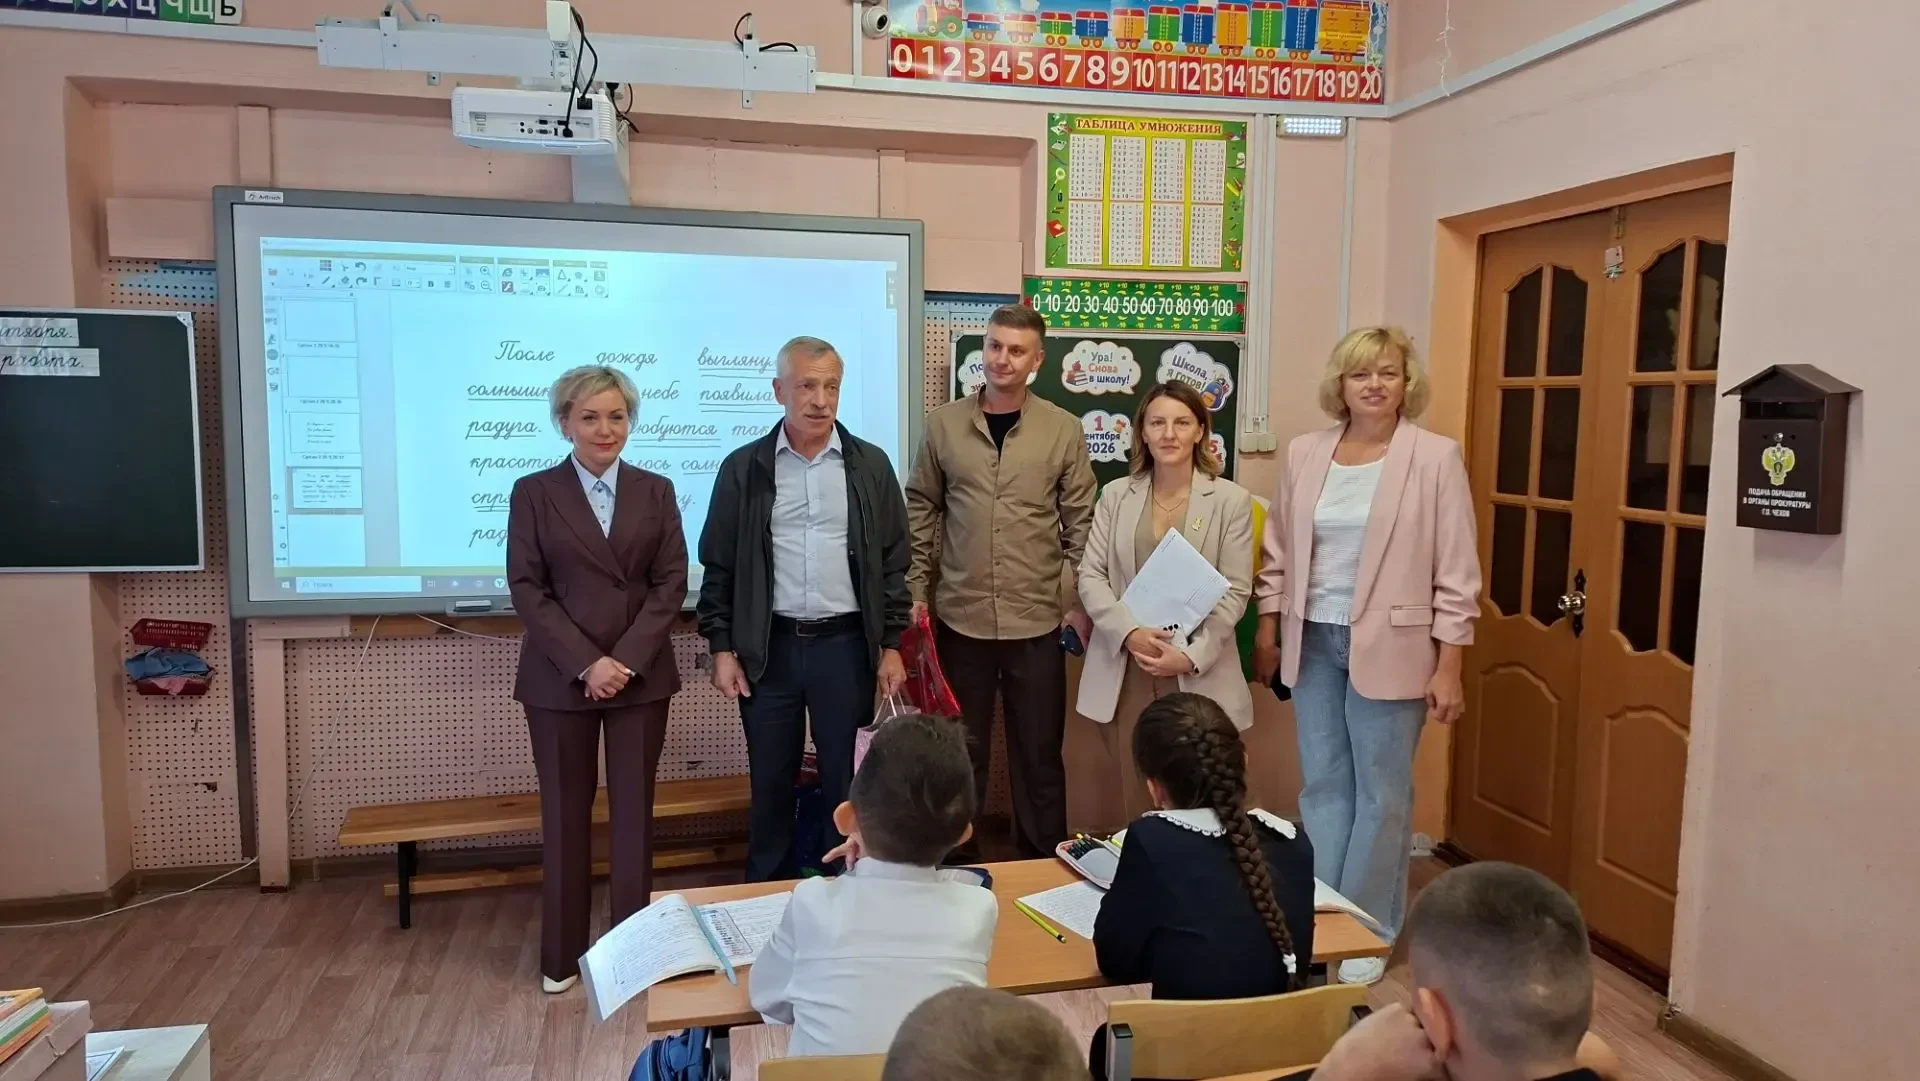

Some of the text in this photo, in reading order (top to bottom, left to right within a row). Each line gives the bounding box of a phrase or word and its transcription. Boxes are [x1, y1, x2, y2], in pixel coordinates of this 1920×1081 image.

[893, 44, 1382, 100] 0 1 2 3 4 5 6 7 8 9 10 11 12 13 14 15 16 17 18 19 20
[1076, 118, 1221, 134] ТАБЛИЦА УМНОЖЕНИЯ
[1033, 293, 1233, 316] 0 10 20 30 40 50 60 70 80 90 100
[0, 318, 73, 344] тября.
[494, 340, 556, 361] После
[595, 351, 658, 372] дождя
[1091, 351, 1113, 364] Ура!
[1088, 363, 1118, 373] Снова
[1172, 354, 1208, 381] Школа,
[1096, 374, 1130, 386] школу!
[467, 380, 775, 401] солнышк небе появила
[464, 420, 542, 440] радуга.
[732, 425, 770, 436] так
[1094, 415, 1104, 431] 1
[1084, 431, 1121, 441] ентября
[681, 459, 720, 471] солн
[1748, 487, 1807, 498] ПОДАЧА ОБРАЩЕНИЯ
[1748, 497, 1770, 505] ОРГАНЫ
[1770, 499, 1812, 509] ПРОКУРАТУРЫ
[1771, 509, 1791, 517] ЧЕХОВ
[468, 529, 508, 548] рад
